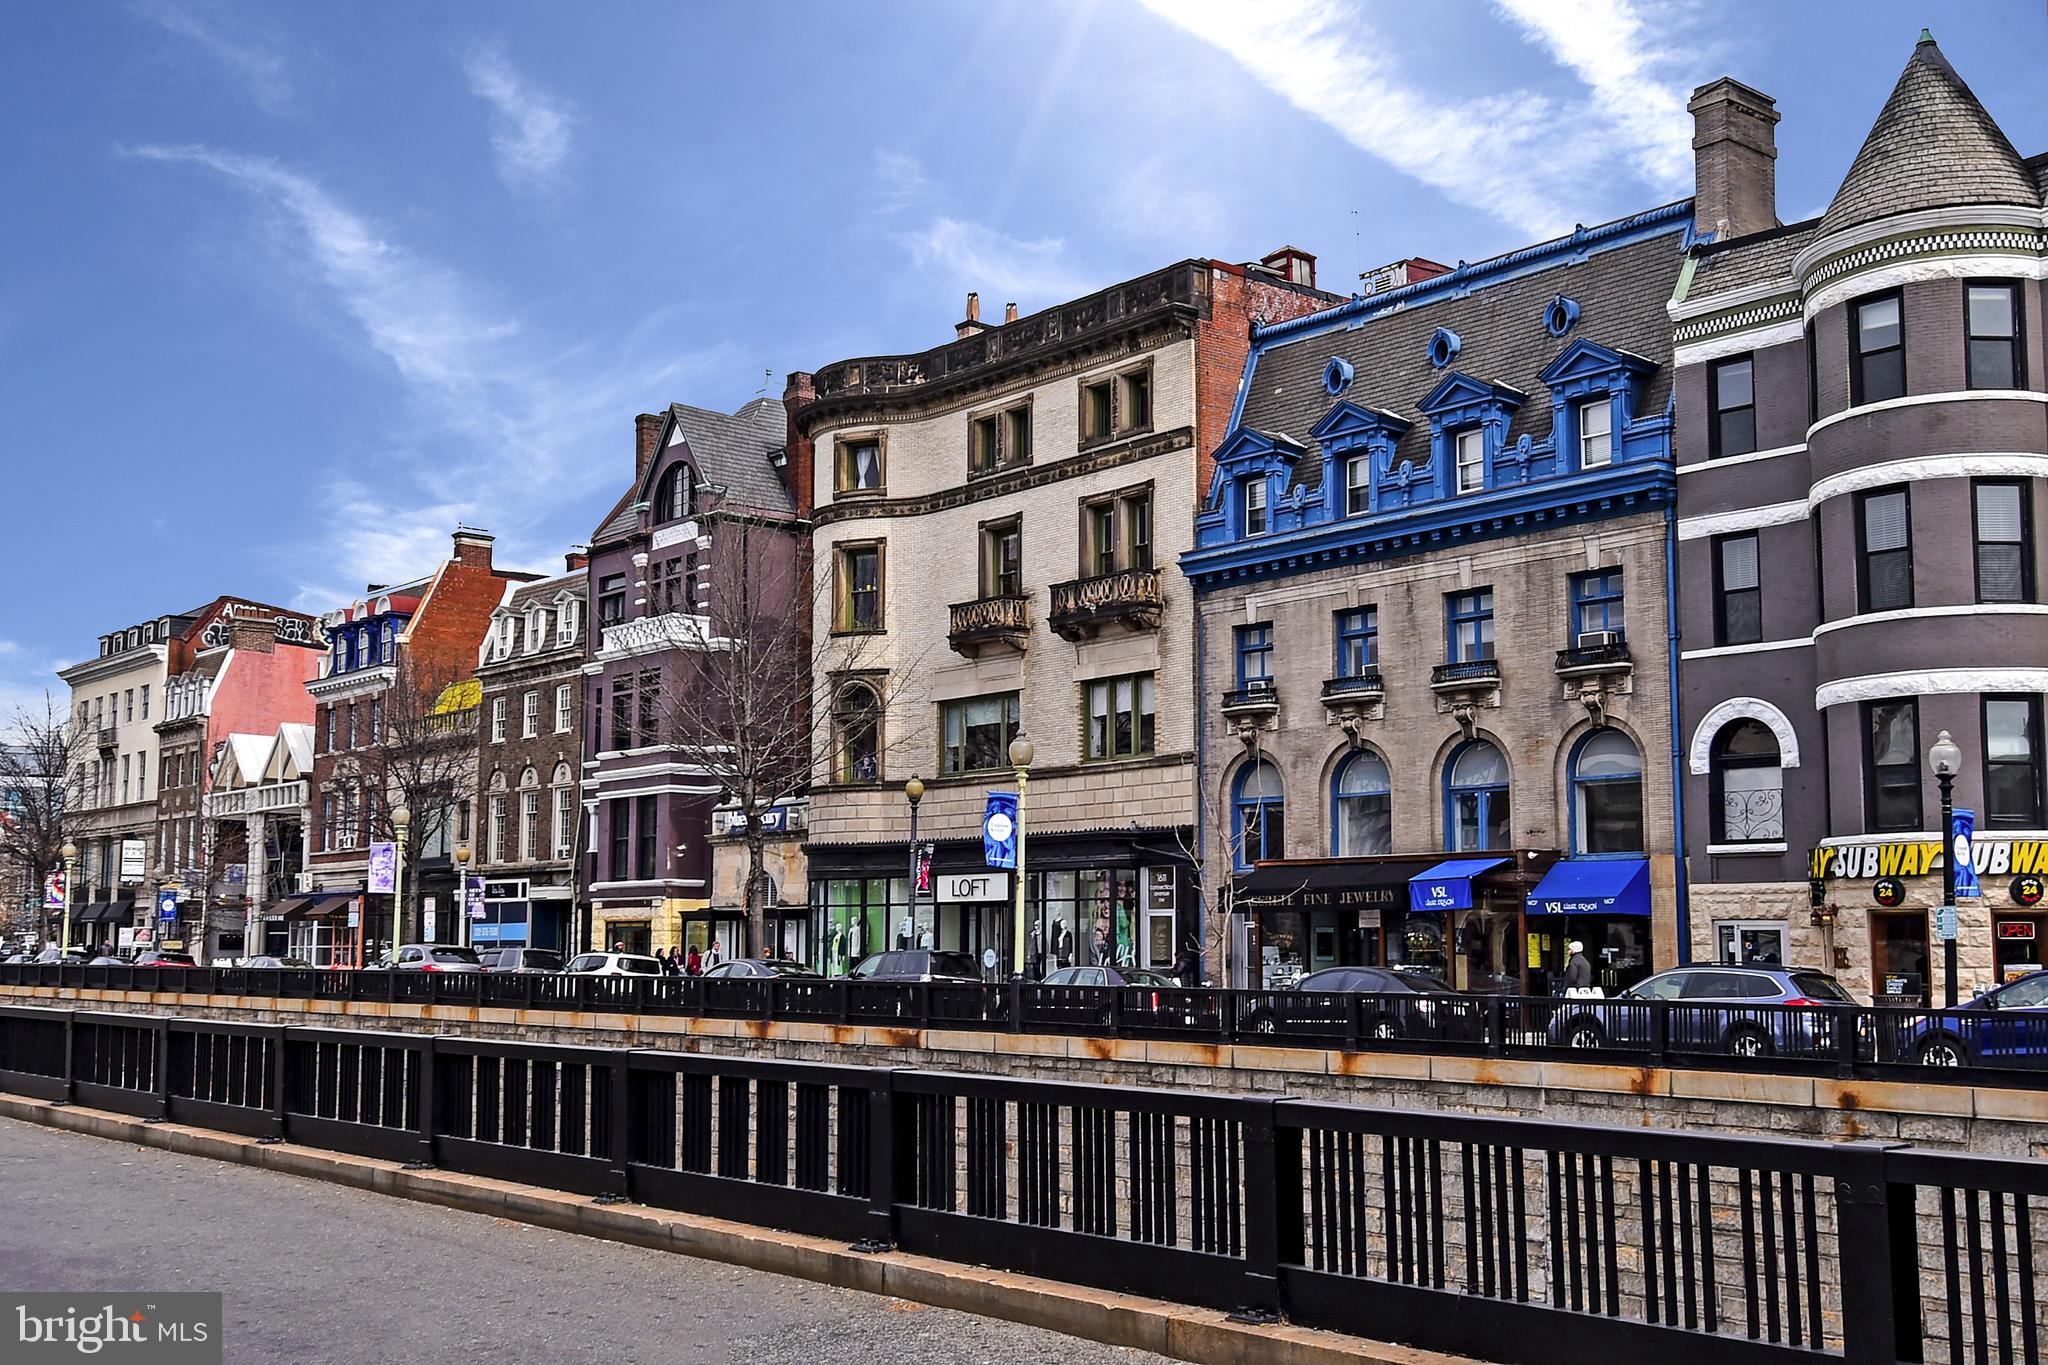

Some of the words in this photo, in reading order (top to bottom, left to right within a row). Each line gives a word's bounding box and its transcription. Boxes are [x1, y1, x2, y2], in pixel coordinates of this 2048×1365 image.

[1835, 843, 1944, 878] SUBWAY
[1971, 841, 2048, 875] UBWA
[951, 878, 990, 897] LOFT
[1431, 886, 1448, 898] VSL
[1879, 888, 1893, 897] 24
[2022, 885, 2038, 895] 24
[1303, 893, 1332, 905] FINE
[1339, 889, 1394, 904] JEWELRY
[1545, 901, 1563, 913] VSL
[2000, 924, 2034, 937] OPEN
